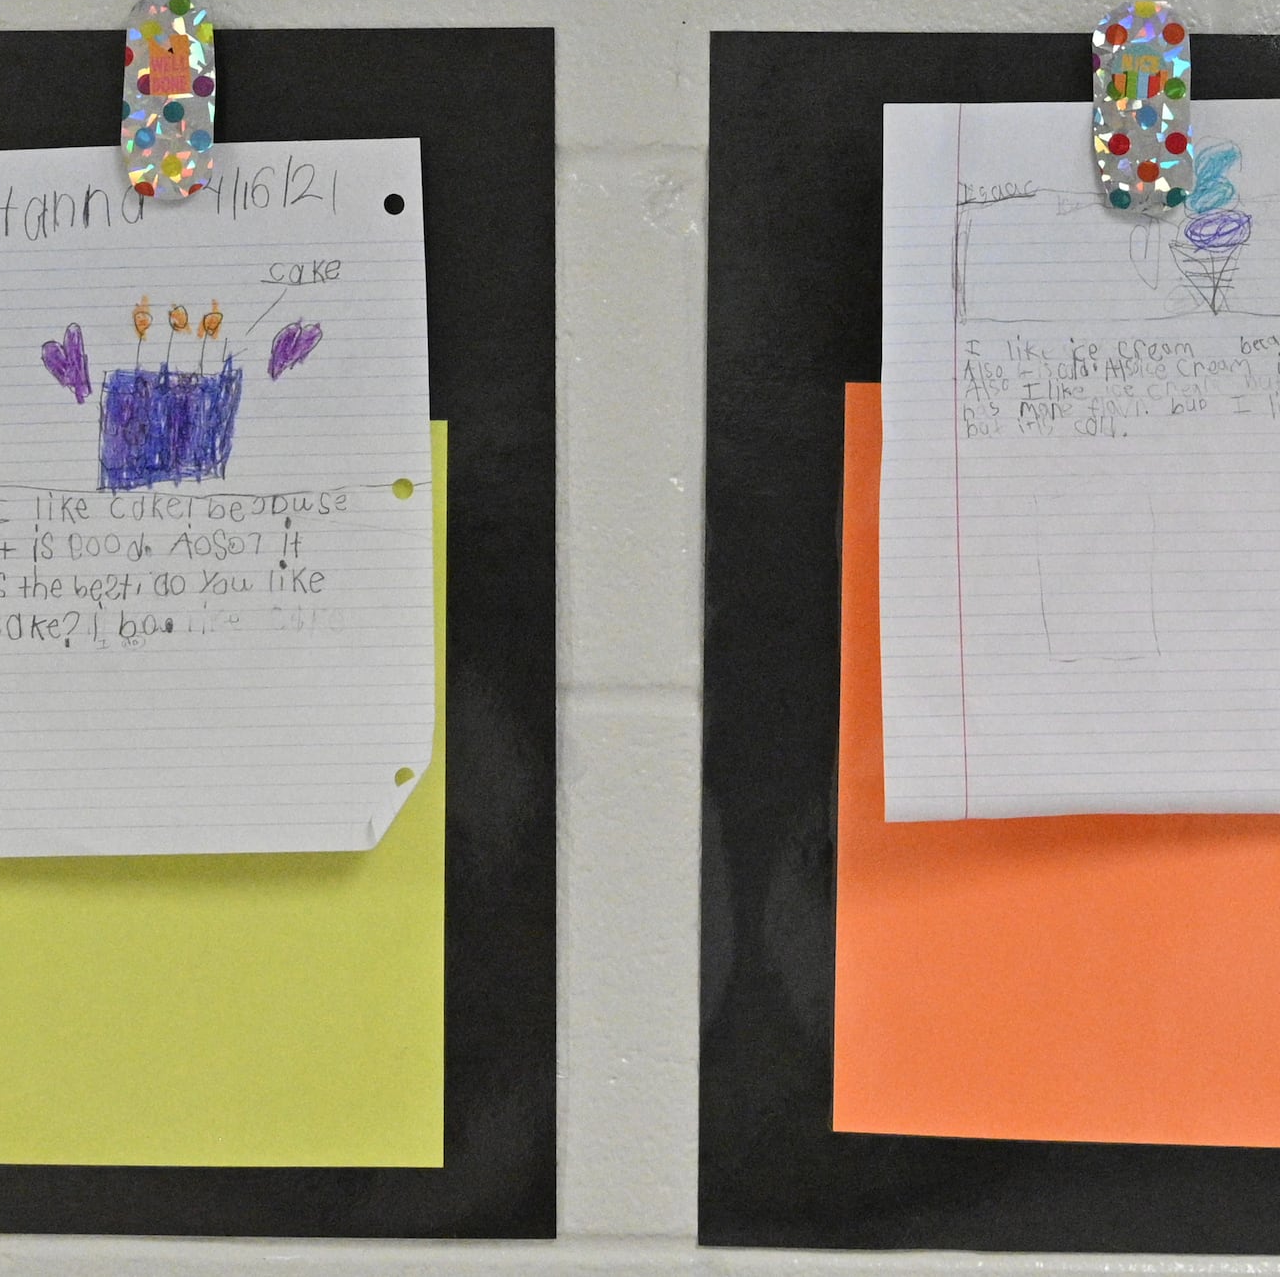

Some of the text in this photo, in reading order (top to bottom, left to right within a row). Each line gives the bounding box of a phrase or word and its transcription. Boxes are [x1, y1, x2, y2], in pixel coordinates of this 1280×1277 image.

[965, 339, 980, 356] I
[36, 491, 90, 524] like
[18, 564, 64, 601] the
[153, 571, 186, 597] do
[269, 560, 326, 595] like
